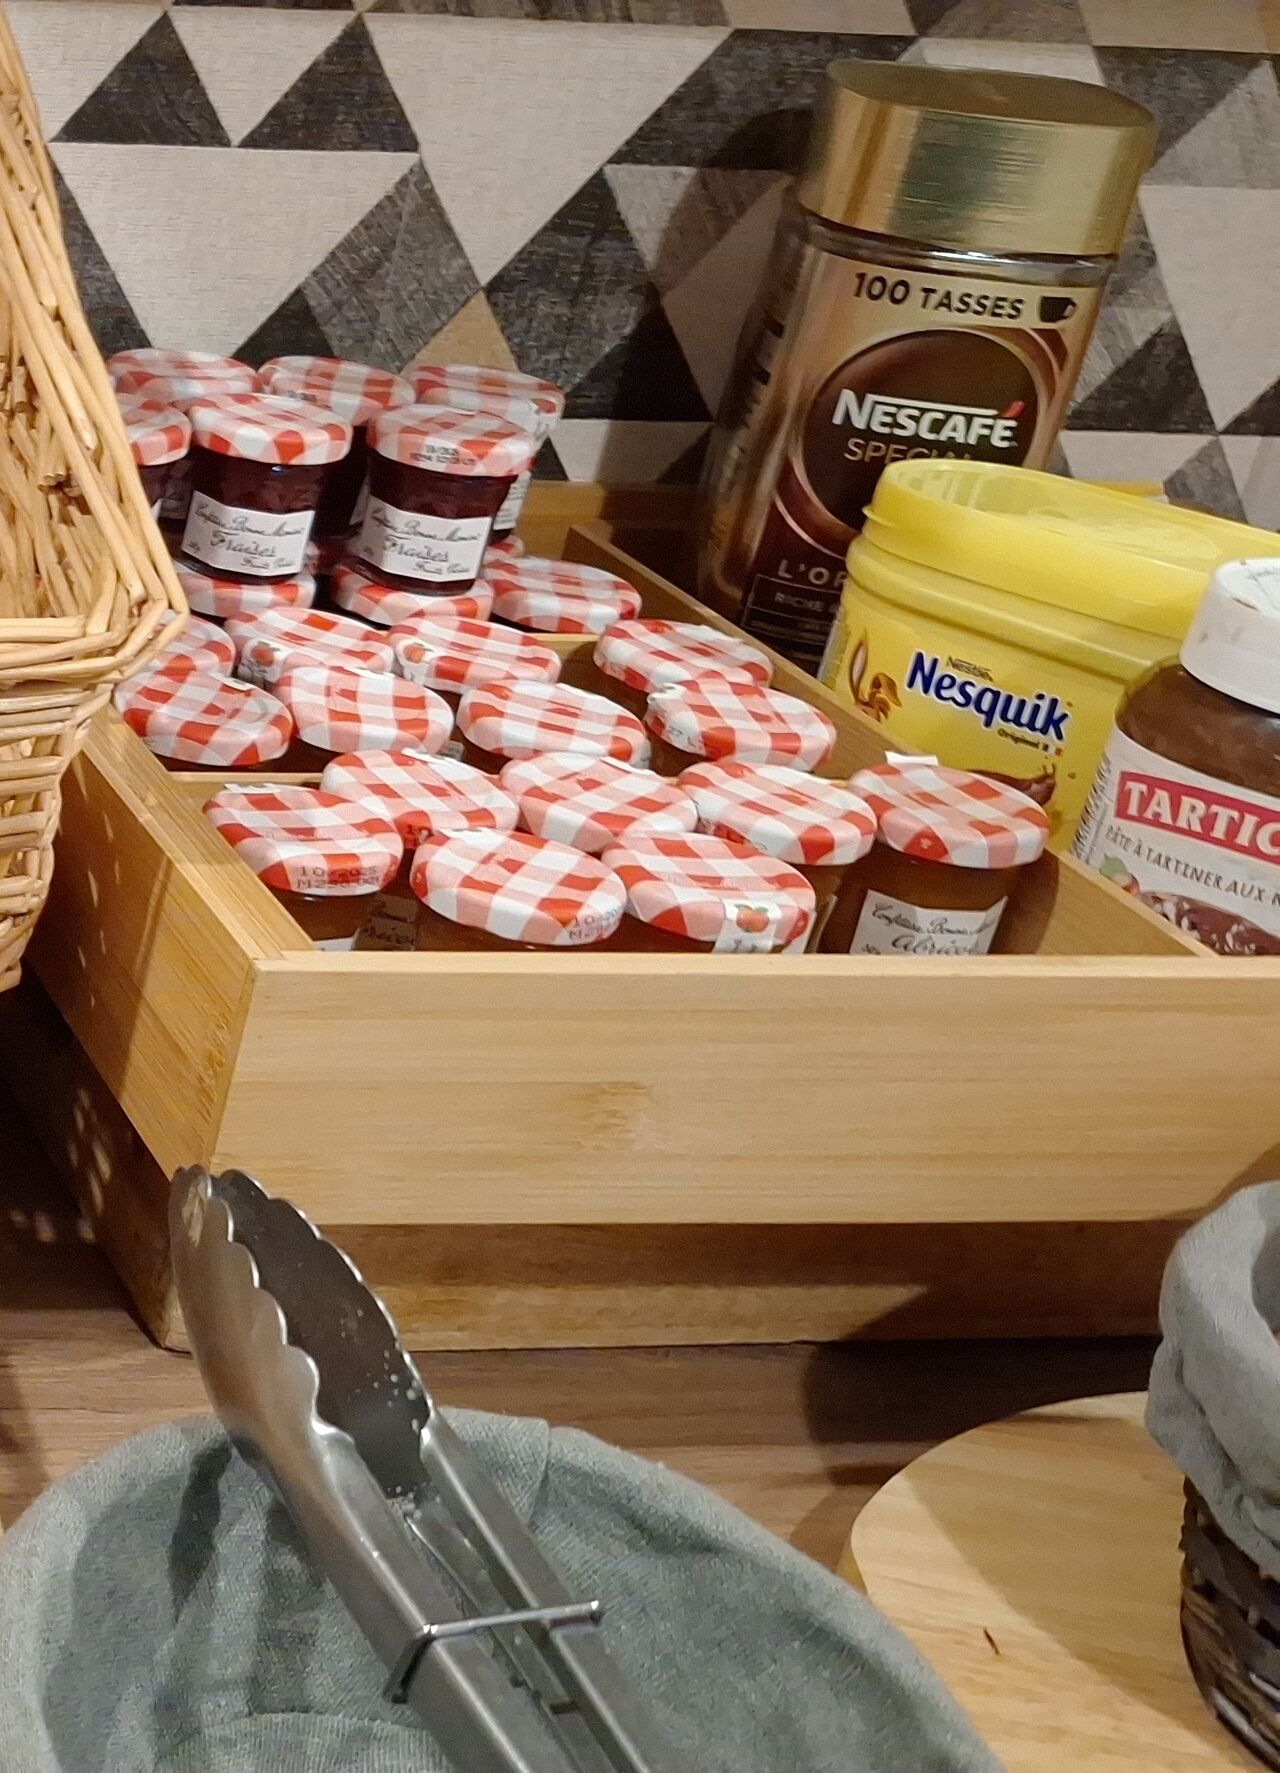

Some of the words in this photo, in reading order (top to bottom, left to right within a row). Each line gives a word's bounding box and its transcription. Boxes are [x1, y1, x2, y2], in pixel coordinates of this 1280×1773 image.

[854, 272, 910, 305] 100
[919, 287, 1026, 320] TASSES
[832, 388, 1026, 448] NESCAFÉ
[843, 437, 972, 465] SPEC
[906, 651, 1070, 742] Nesquik
[1145, 847, 1224, 891] TARTINER
[1225, 879, 1270, 904] AUX
